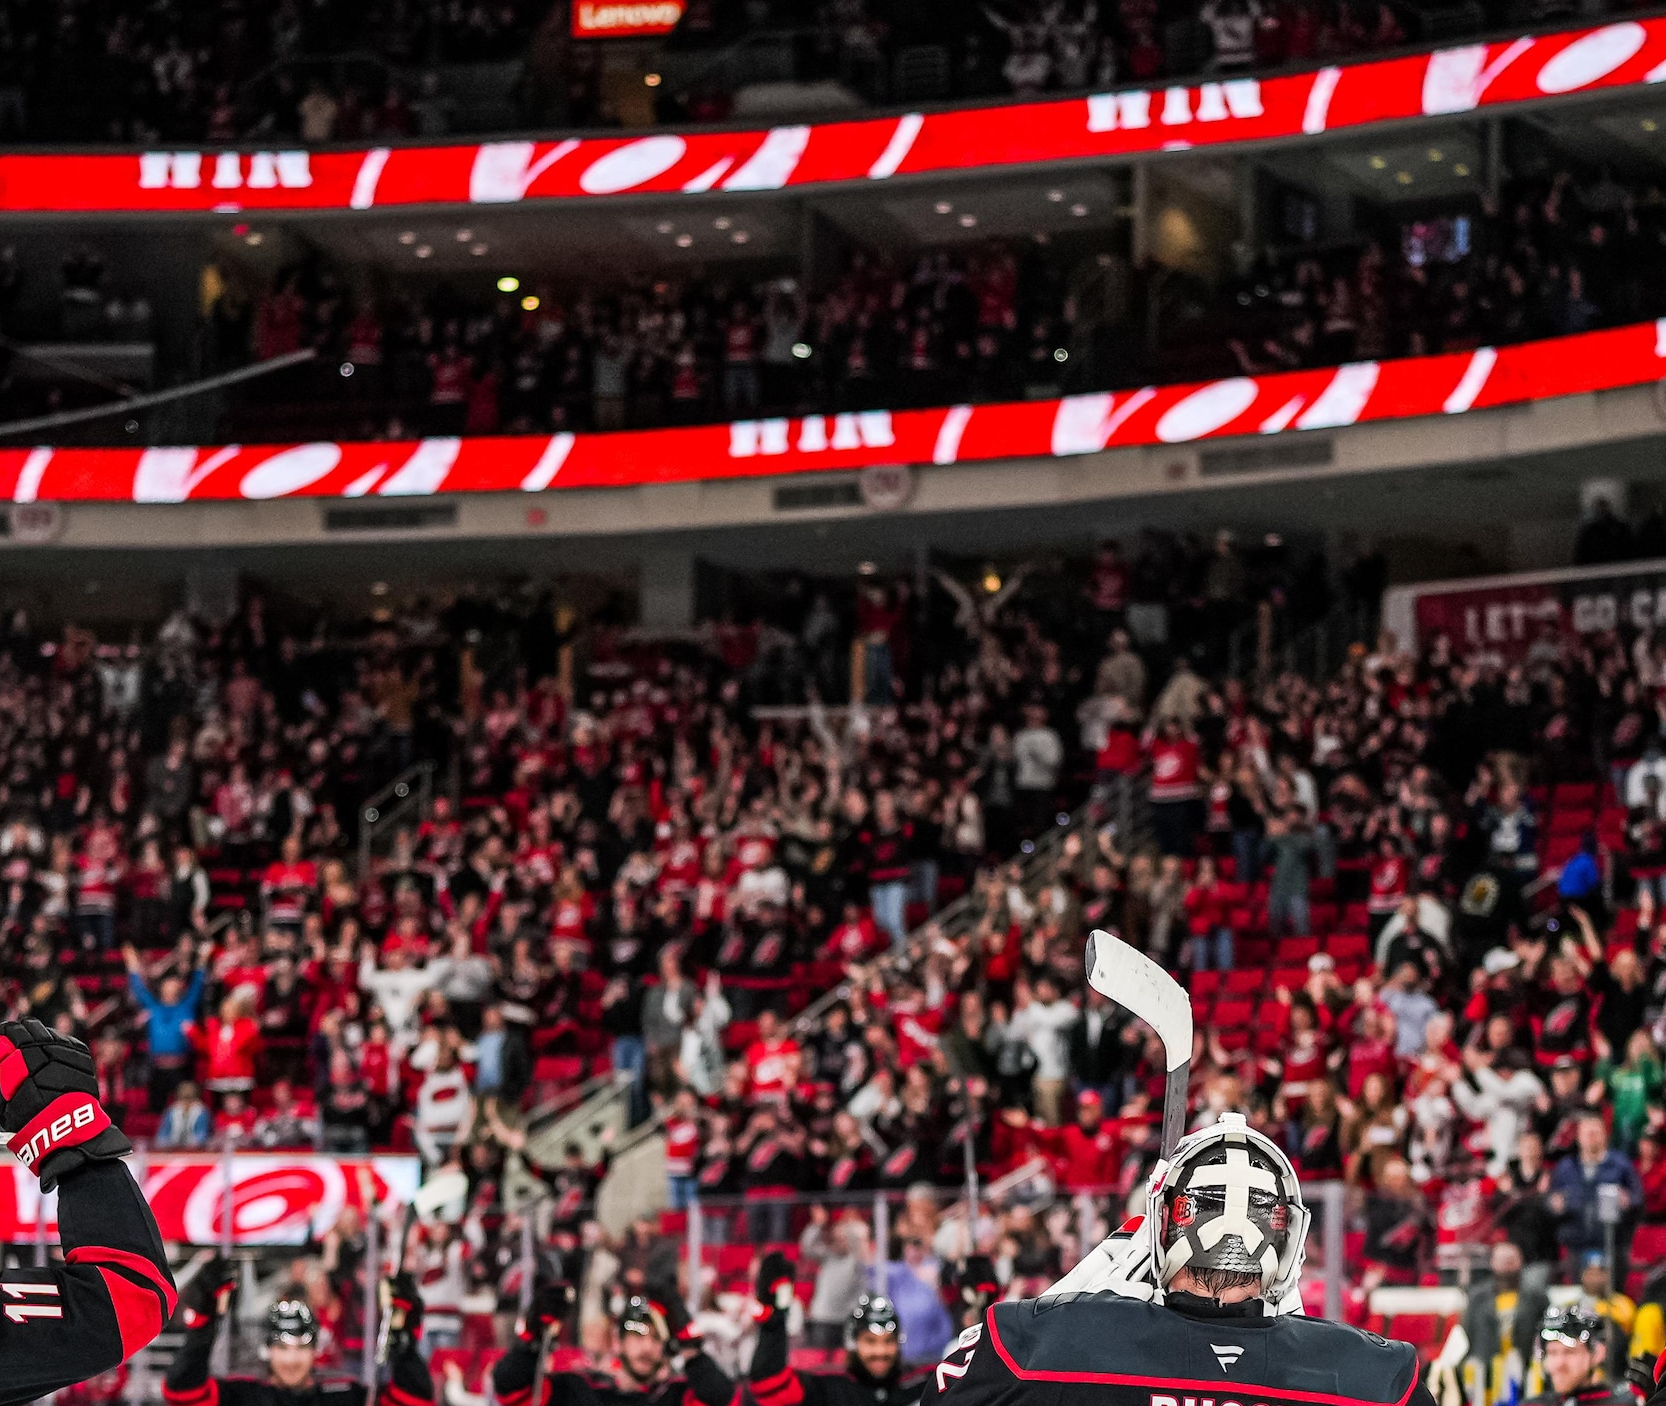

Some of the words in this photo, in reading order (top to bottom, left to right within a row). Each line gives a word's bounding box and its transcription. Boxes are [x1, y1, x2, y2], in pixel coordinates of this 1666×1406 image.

[579, 2, 683, 30] Lenovo
[1573, 594, 1617, 635] GO
[0, 1283, 63, 1324] 11
